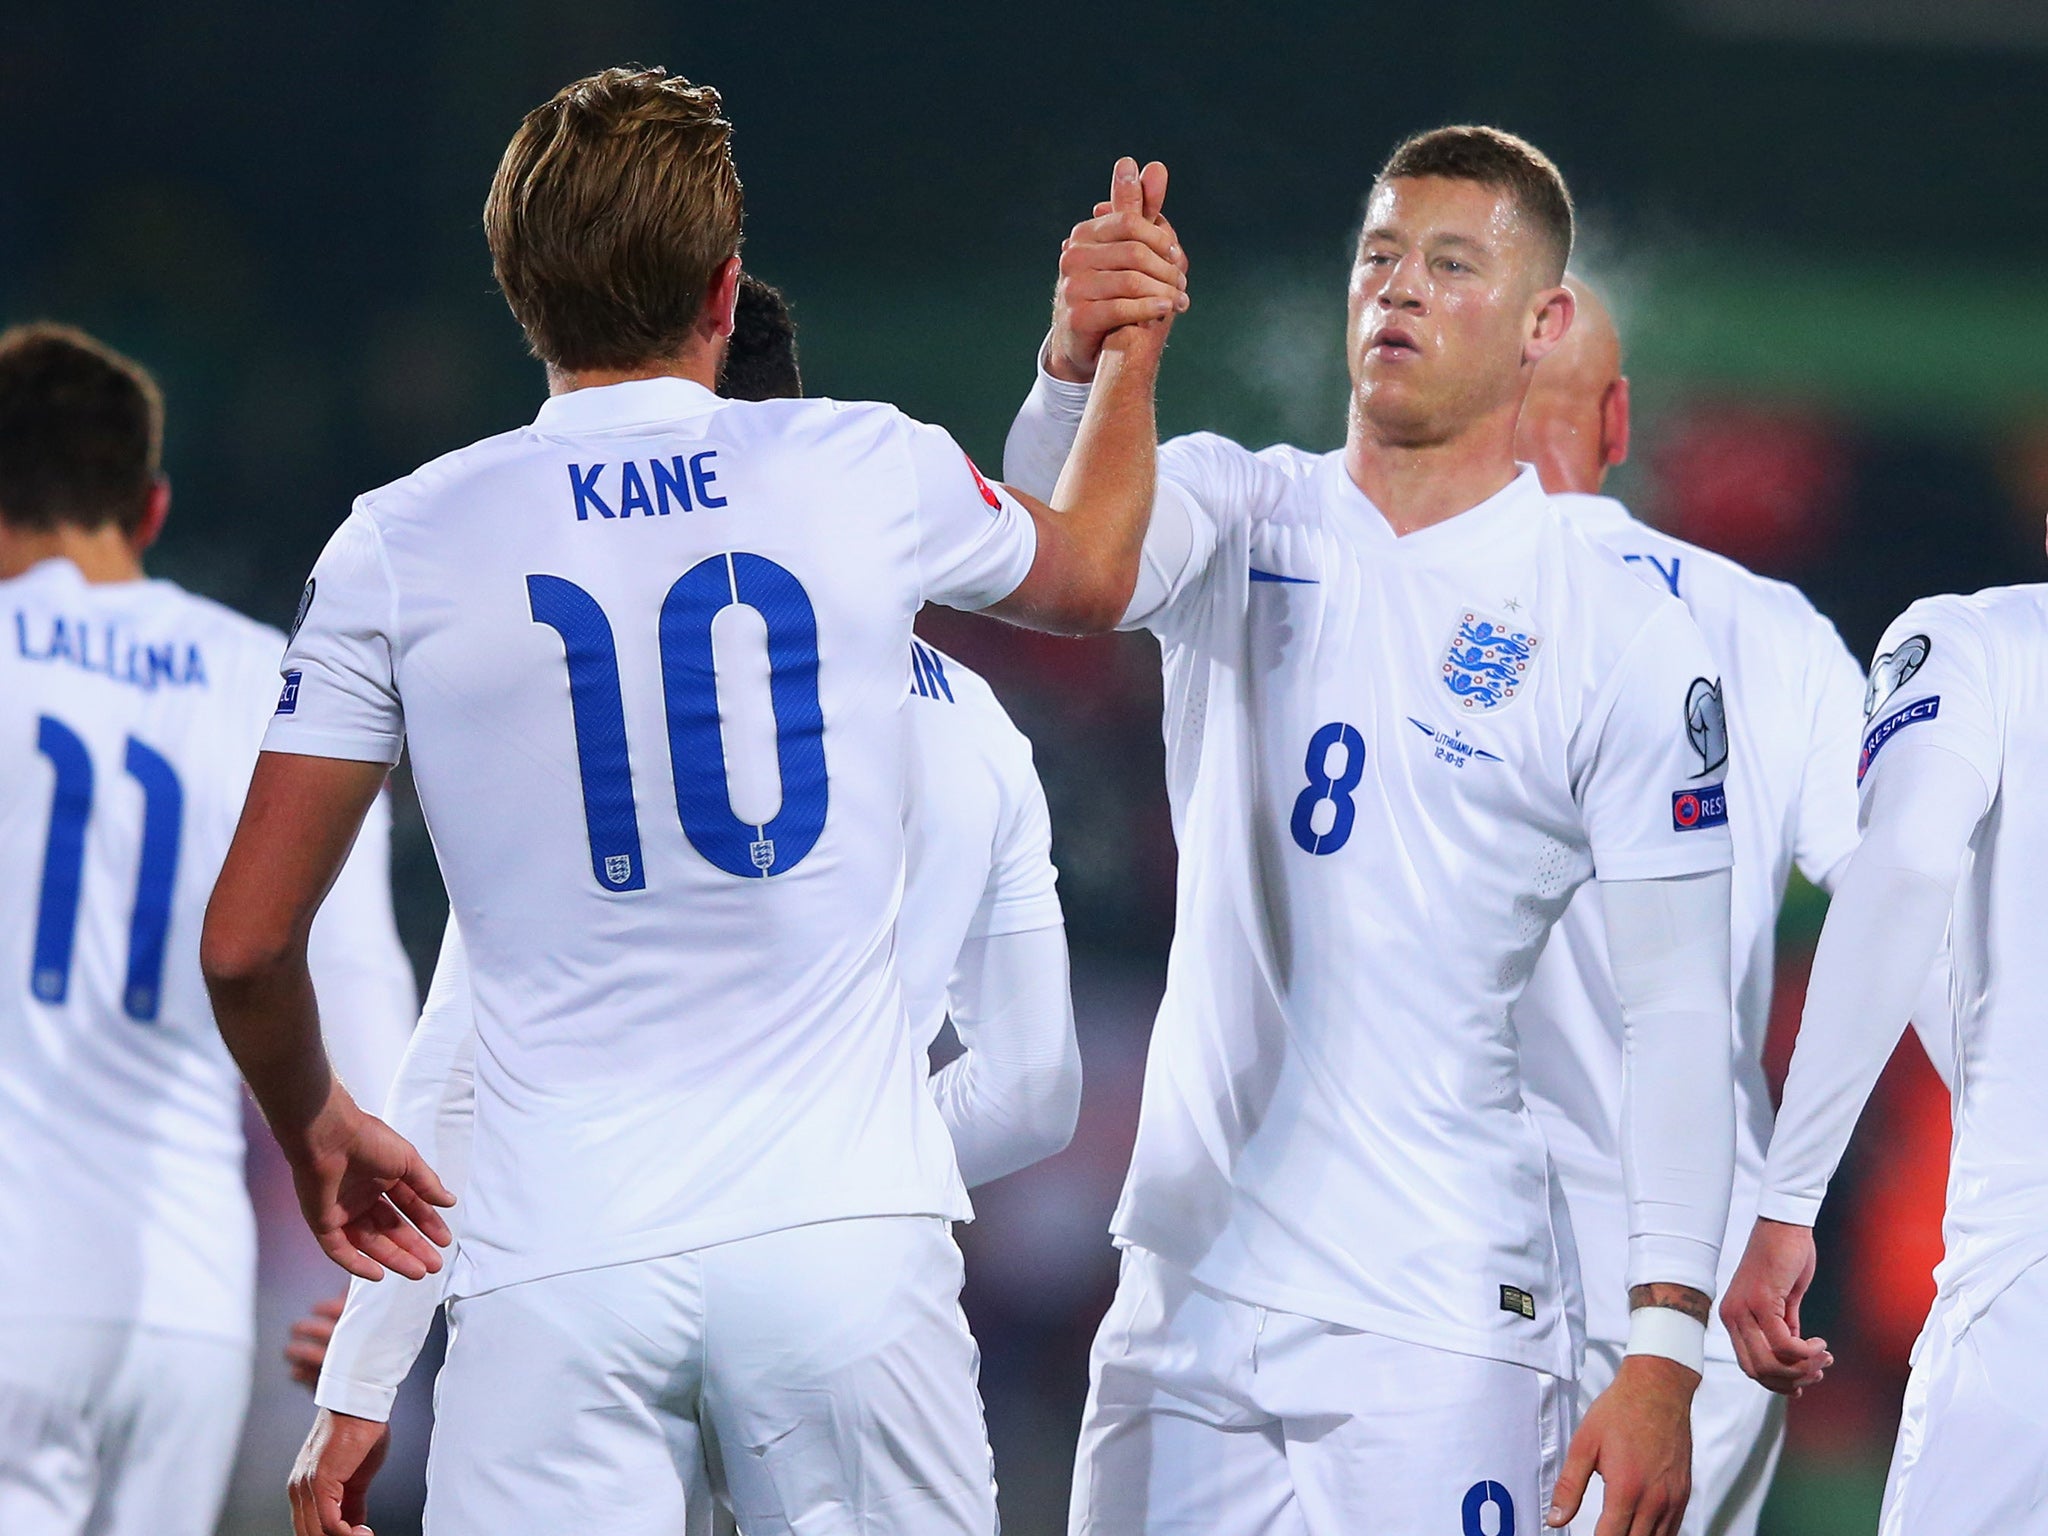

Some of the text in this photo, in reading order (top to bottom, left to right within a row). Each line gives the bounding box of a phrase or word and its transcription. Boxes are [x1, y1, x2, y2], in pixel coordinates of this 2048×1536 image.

[567, 450, 728, 521] KANE
[1623, 555, 1680, 598] Y
[910, 641, 954, 703] IN
[525, 552, 828, 892] 10
[1434, 731, 1474, 757] LITHUANIA
[1867, 702, 1937, 754] RESPECT
[1434, 746, 1466, 768] 12-10-15
[1290, 721, 1366, 856] 8
[31, 713, 183, 1022] 11
